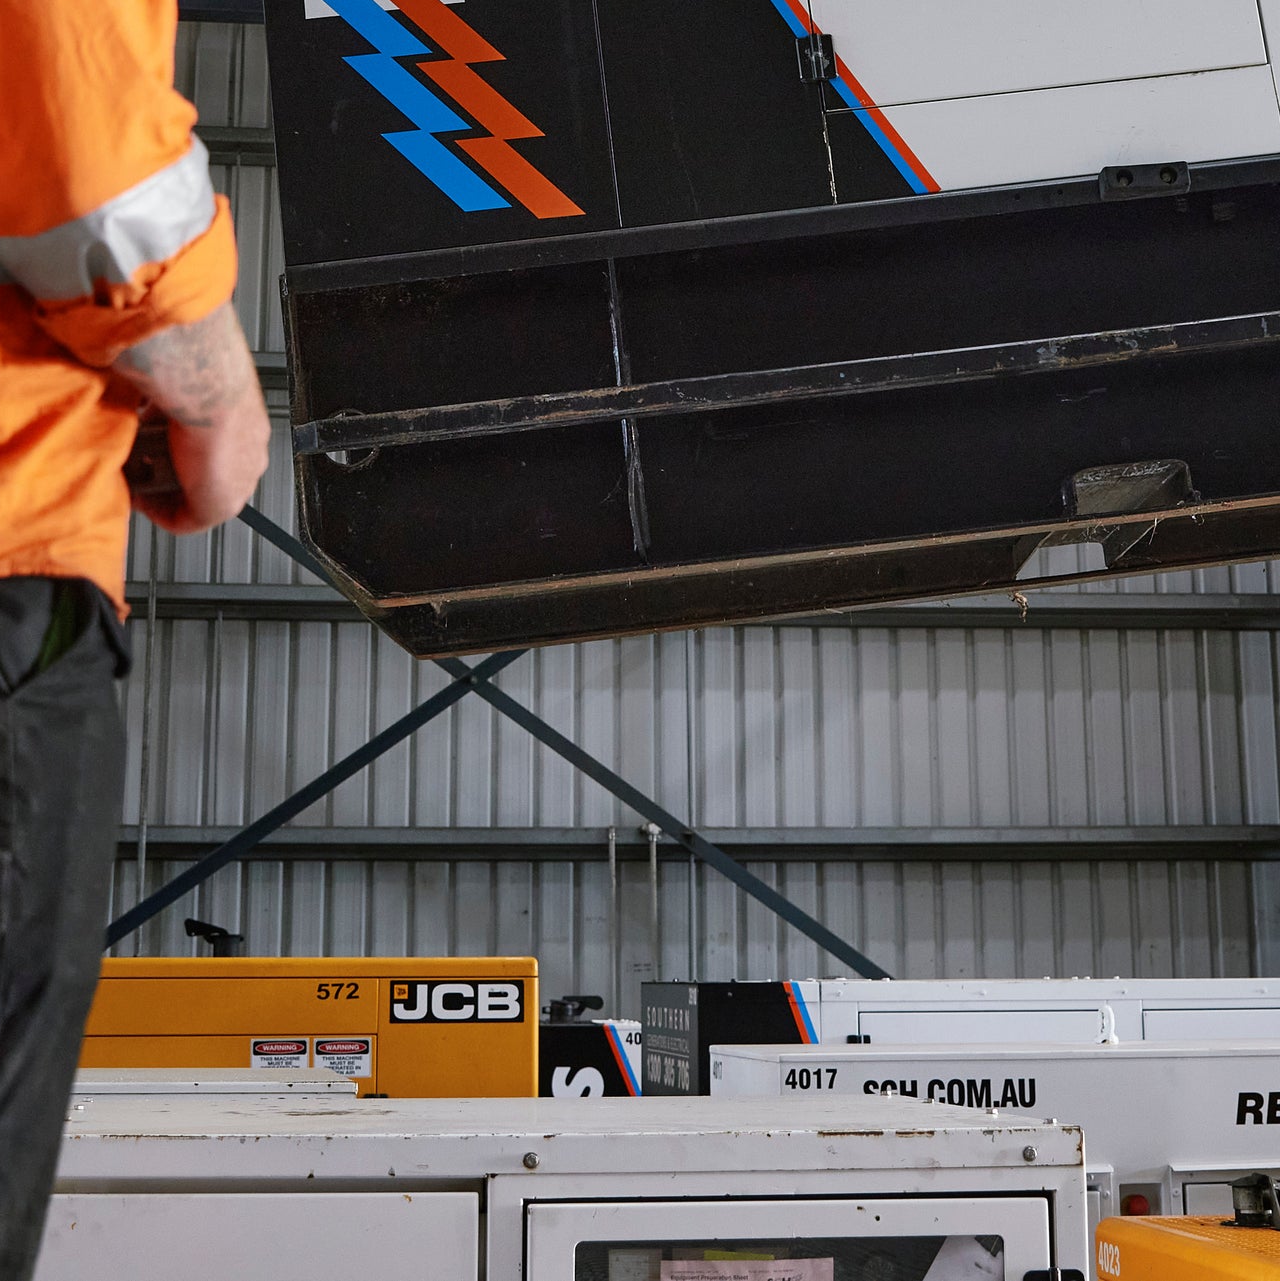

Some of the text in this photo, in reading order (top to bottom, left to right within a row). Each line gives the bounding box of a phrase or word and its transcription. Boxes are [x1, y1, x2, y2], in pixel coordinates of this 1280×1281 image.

[316, 982, 360, 1000] 572
[393, 983, 521, 1020] JCB
[646, 1006, 690, 1032] SOUTHERN
[785, 1068, 838, 1090] 4017
[1098, 1241, 1120, 1277] 4023
